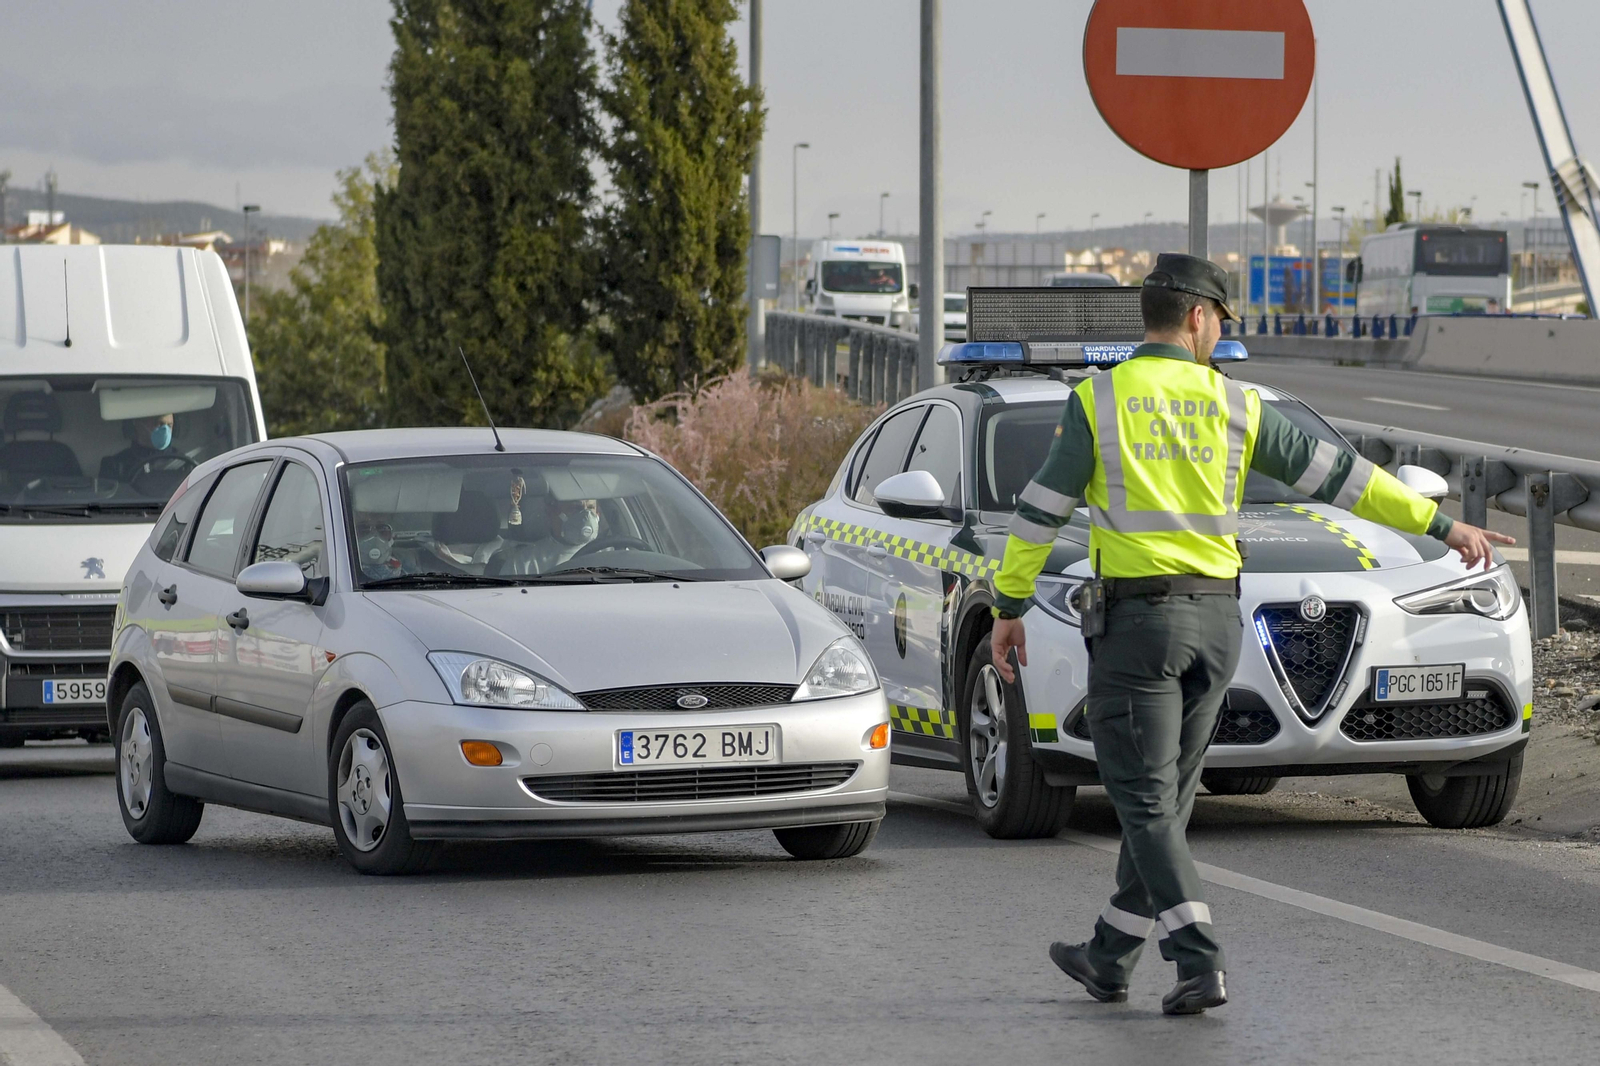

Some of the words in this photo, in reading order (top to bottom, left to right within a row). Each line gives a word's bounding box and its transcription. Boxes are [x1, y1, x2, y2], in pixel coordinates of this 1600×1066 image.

[1126, 396, 1219, 417] GUARDIA
[1150, 419, 1198, 440] CIVIL
[1133, 443, 1214, 464] TRAFICO
[56, 682, 106, 700] 5959
[637, 733, 707, 759] 3762
[721, 731, 769, 757] BMJ
